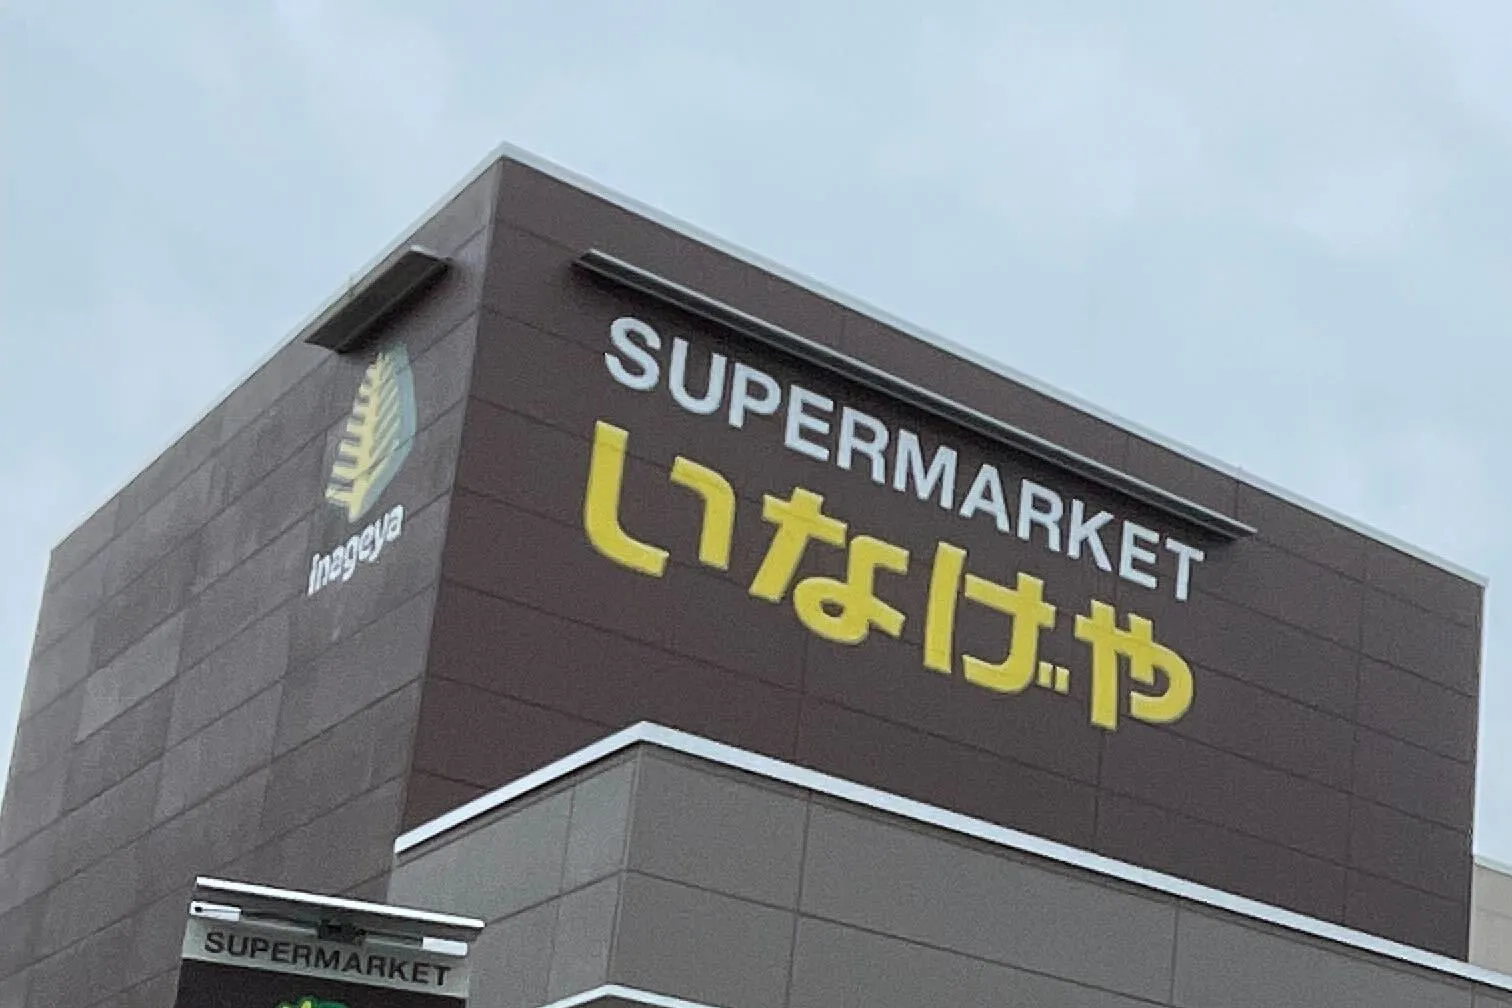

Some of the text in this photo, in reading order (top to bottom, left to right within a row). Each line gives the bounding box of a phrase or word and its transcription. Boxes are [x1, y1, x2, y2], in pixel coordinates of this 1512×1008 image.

[307, 504, 404, 596] inageya
[604, 314, 1205, 603] SUPERMARKET
[582, 420, 1196, 730] いなげや
[203, 930, 453, 988] SUPERMARKET
